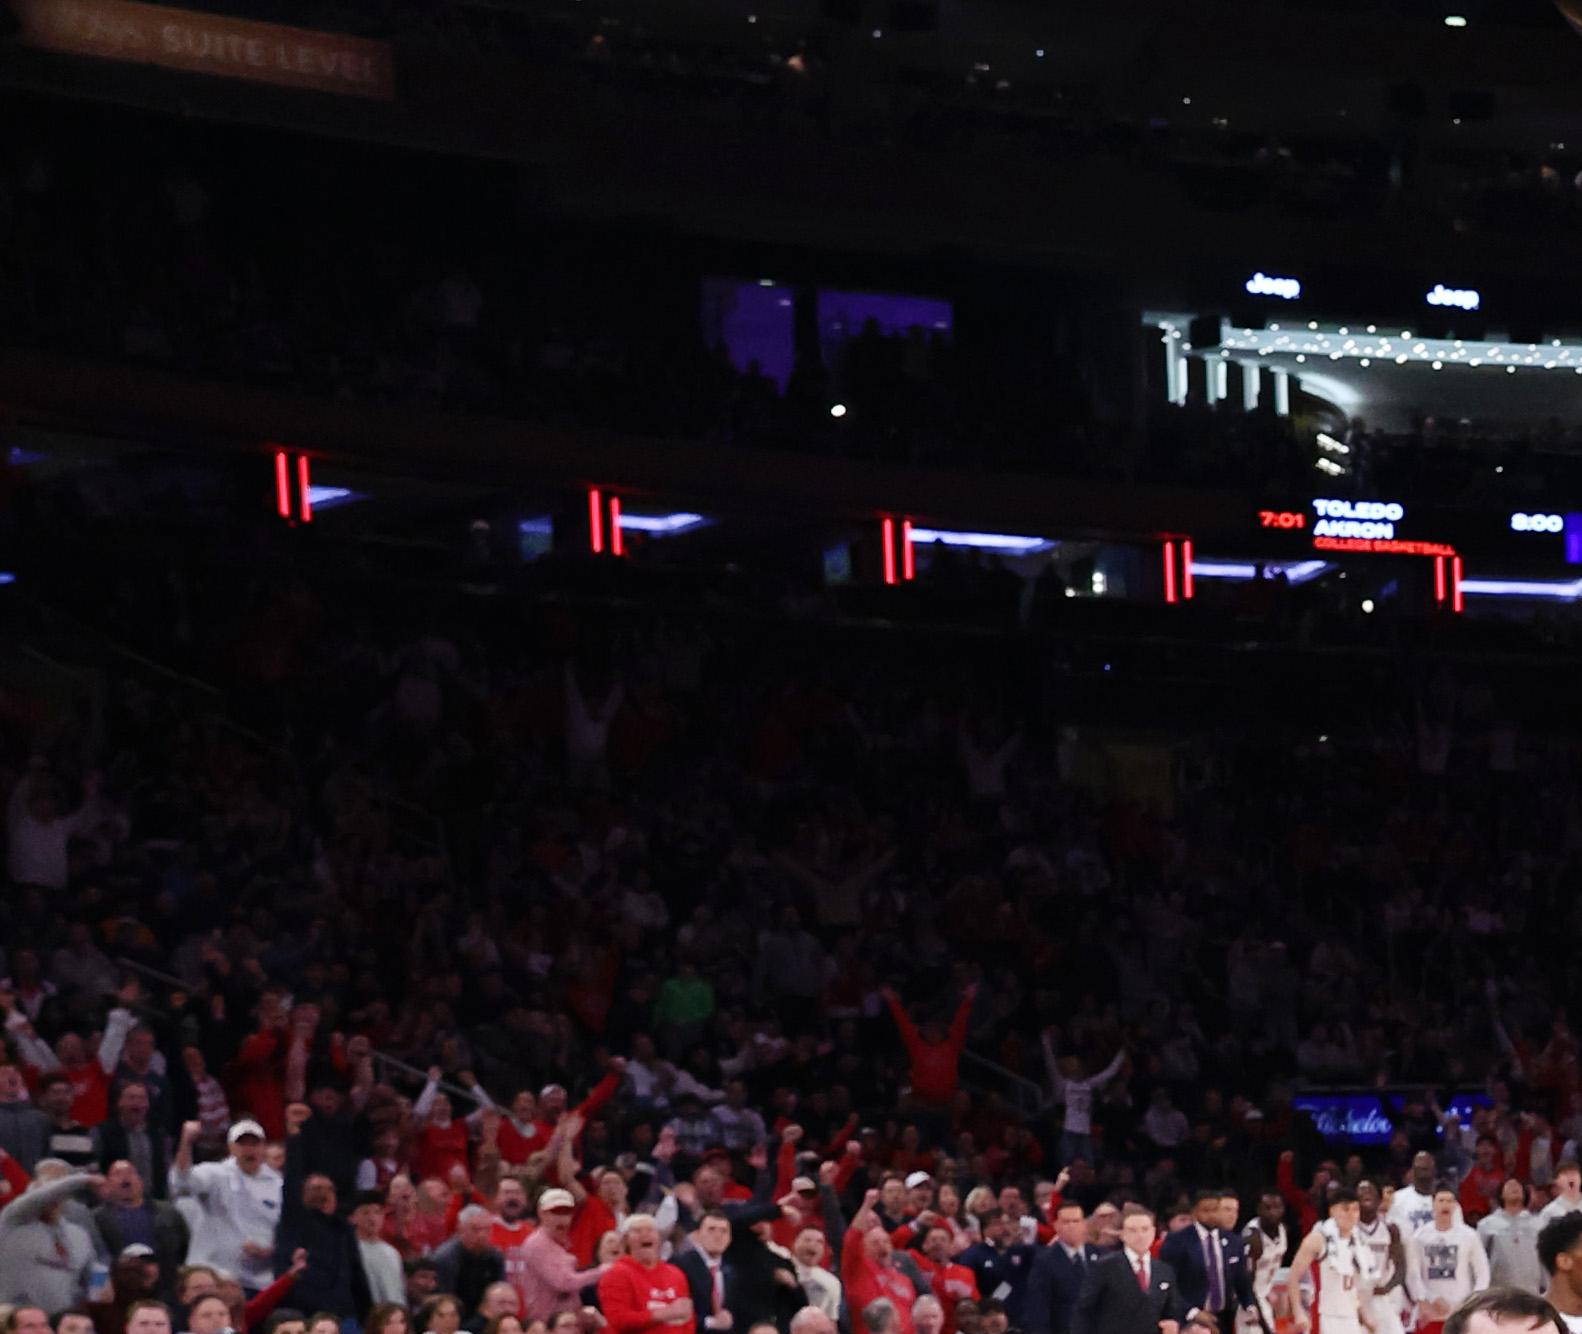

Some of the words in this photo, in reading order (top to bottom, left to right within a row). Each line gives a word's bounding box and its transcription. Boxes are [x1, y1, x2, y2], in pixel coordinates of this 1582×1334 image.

[1246, 272, 1300, 298] Jeep
[1427, 285, 1479, 309] Jeep
[1259, 511, 1304, 529] 7:01
[1313, 498, 1403, 520] TOLEDO
[1313, 519, 1394, 539] AKRON
